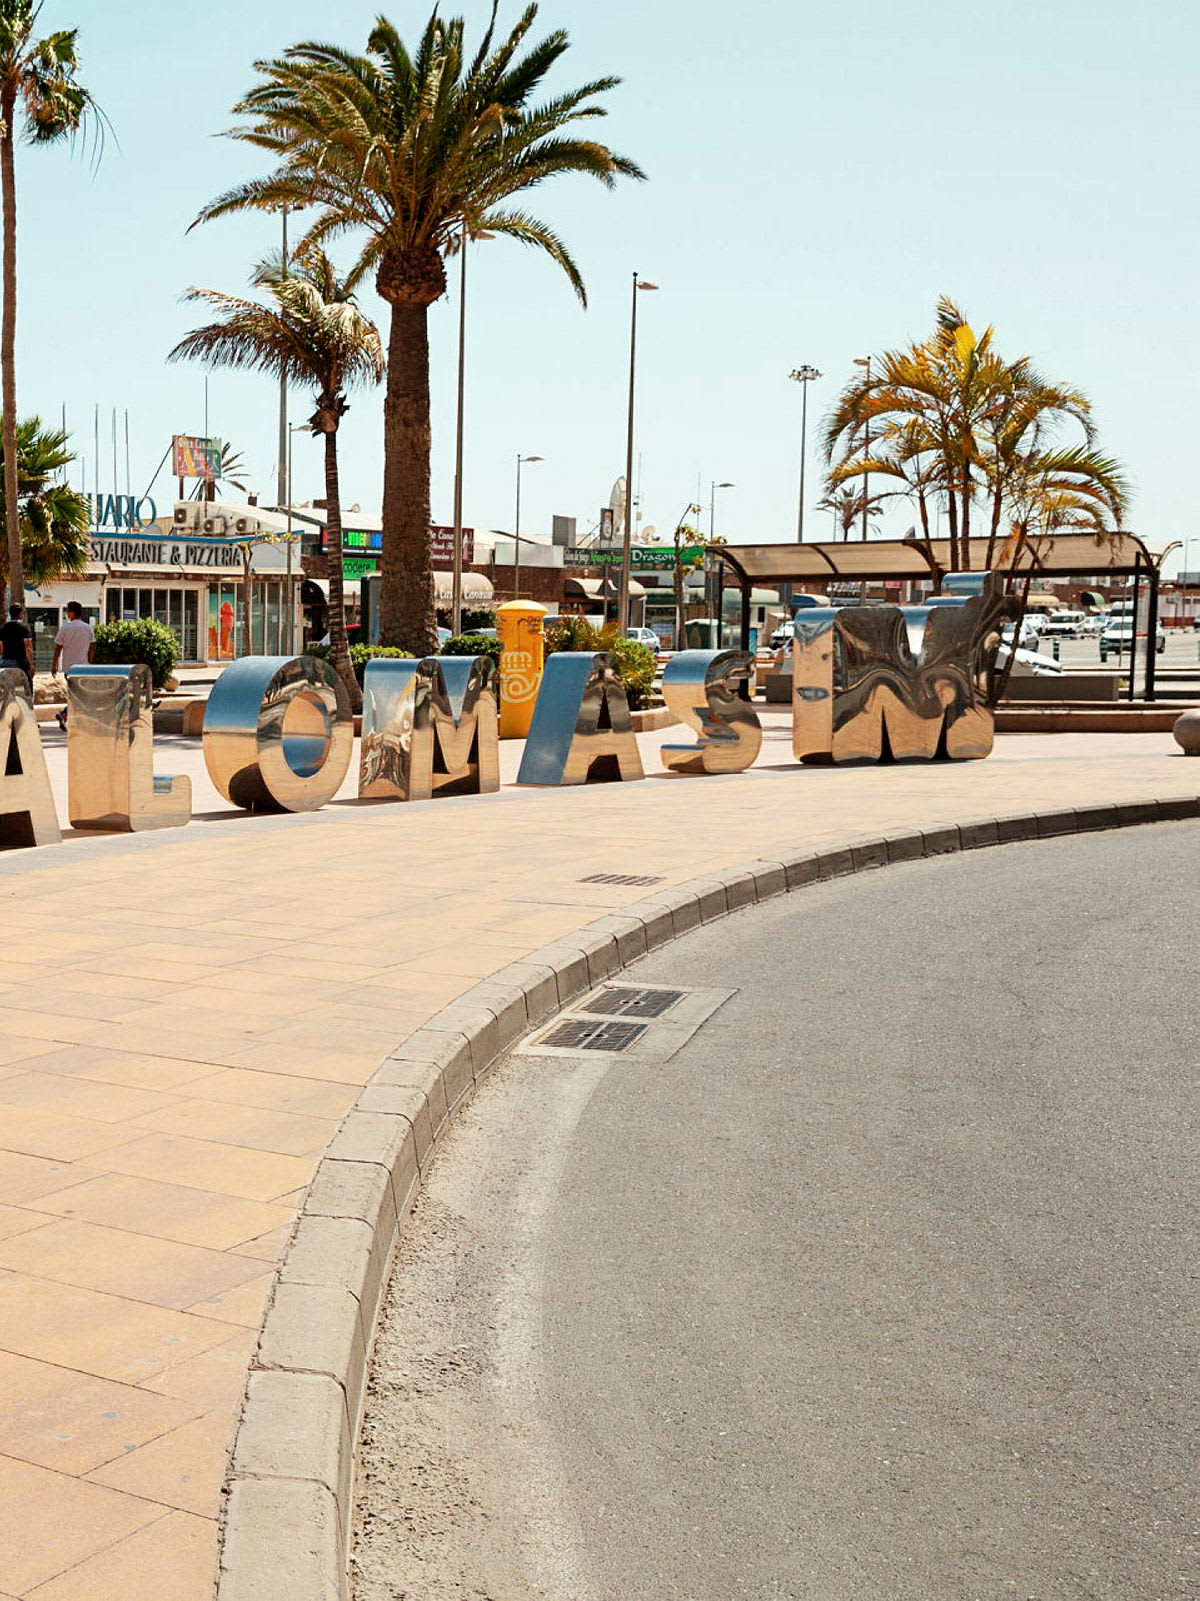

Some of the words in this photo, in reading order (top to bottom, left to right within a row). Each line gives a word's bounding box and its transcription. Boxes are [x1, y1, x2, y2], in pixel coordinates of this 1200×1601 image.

[87, 493, 157, 529] UARIO
[90, 540, 167, 565] STAURANTE
[170, 546, 182, 565] &
[632, 550, 676, 563] Dragon
[343, 560, 371, 573] codere
